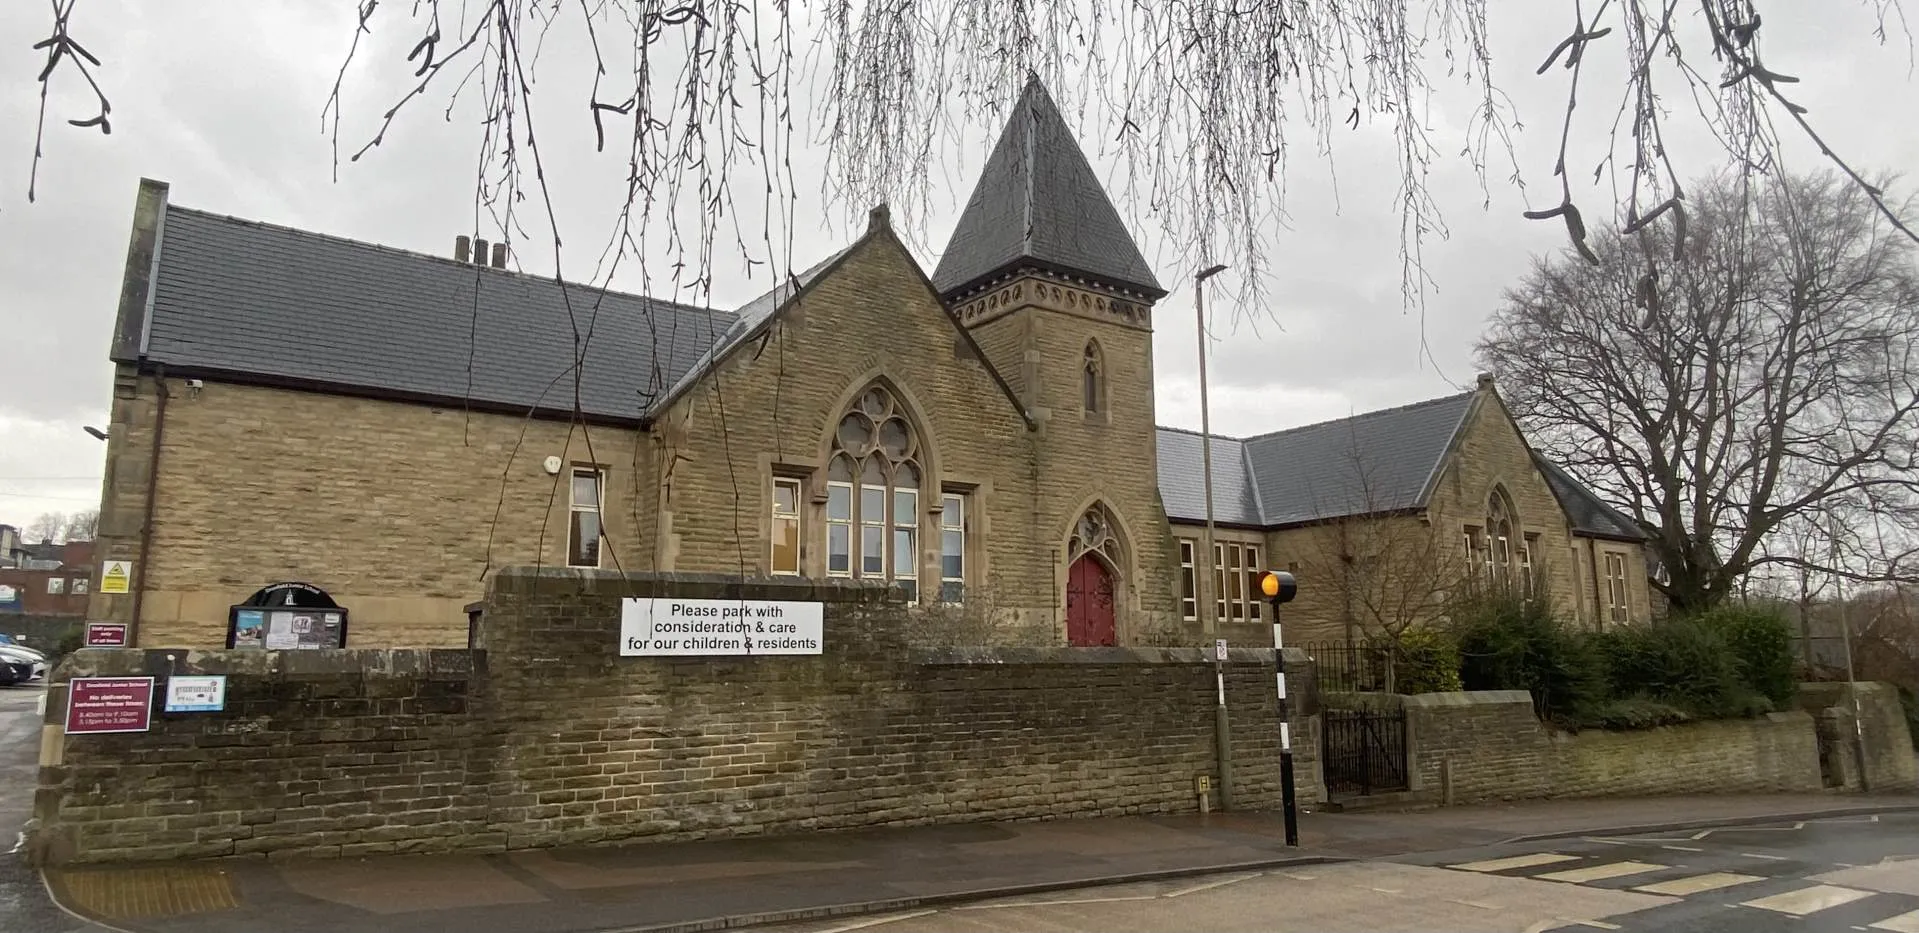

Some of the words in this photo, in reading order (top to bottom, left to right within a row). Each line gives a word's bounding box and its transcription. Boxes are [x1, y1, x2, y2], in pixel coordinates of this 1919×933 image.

[671, 604, 718, 617] Please
[722, 605, 752, 620] park
[756, 606, 783, 617] with
[654, 621, 751, 633] consideration
[755, 622, 765, 633] &
[769, 624, 797, 633] care
[628, 637, 650, 650] for
[653, 639, 679, 650] our
[683, 637, 740, 650] children
[744, 638, 753, 649] &
[757, 637, 817, 650] residents
[1201, 777, 1208, 788] H
